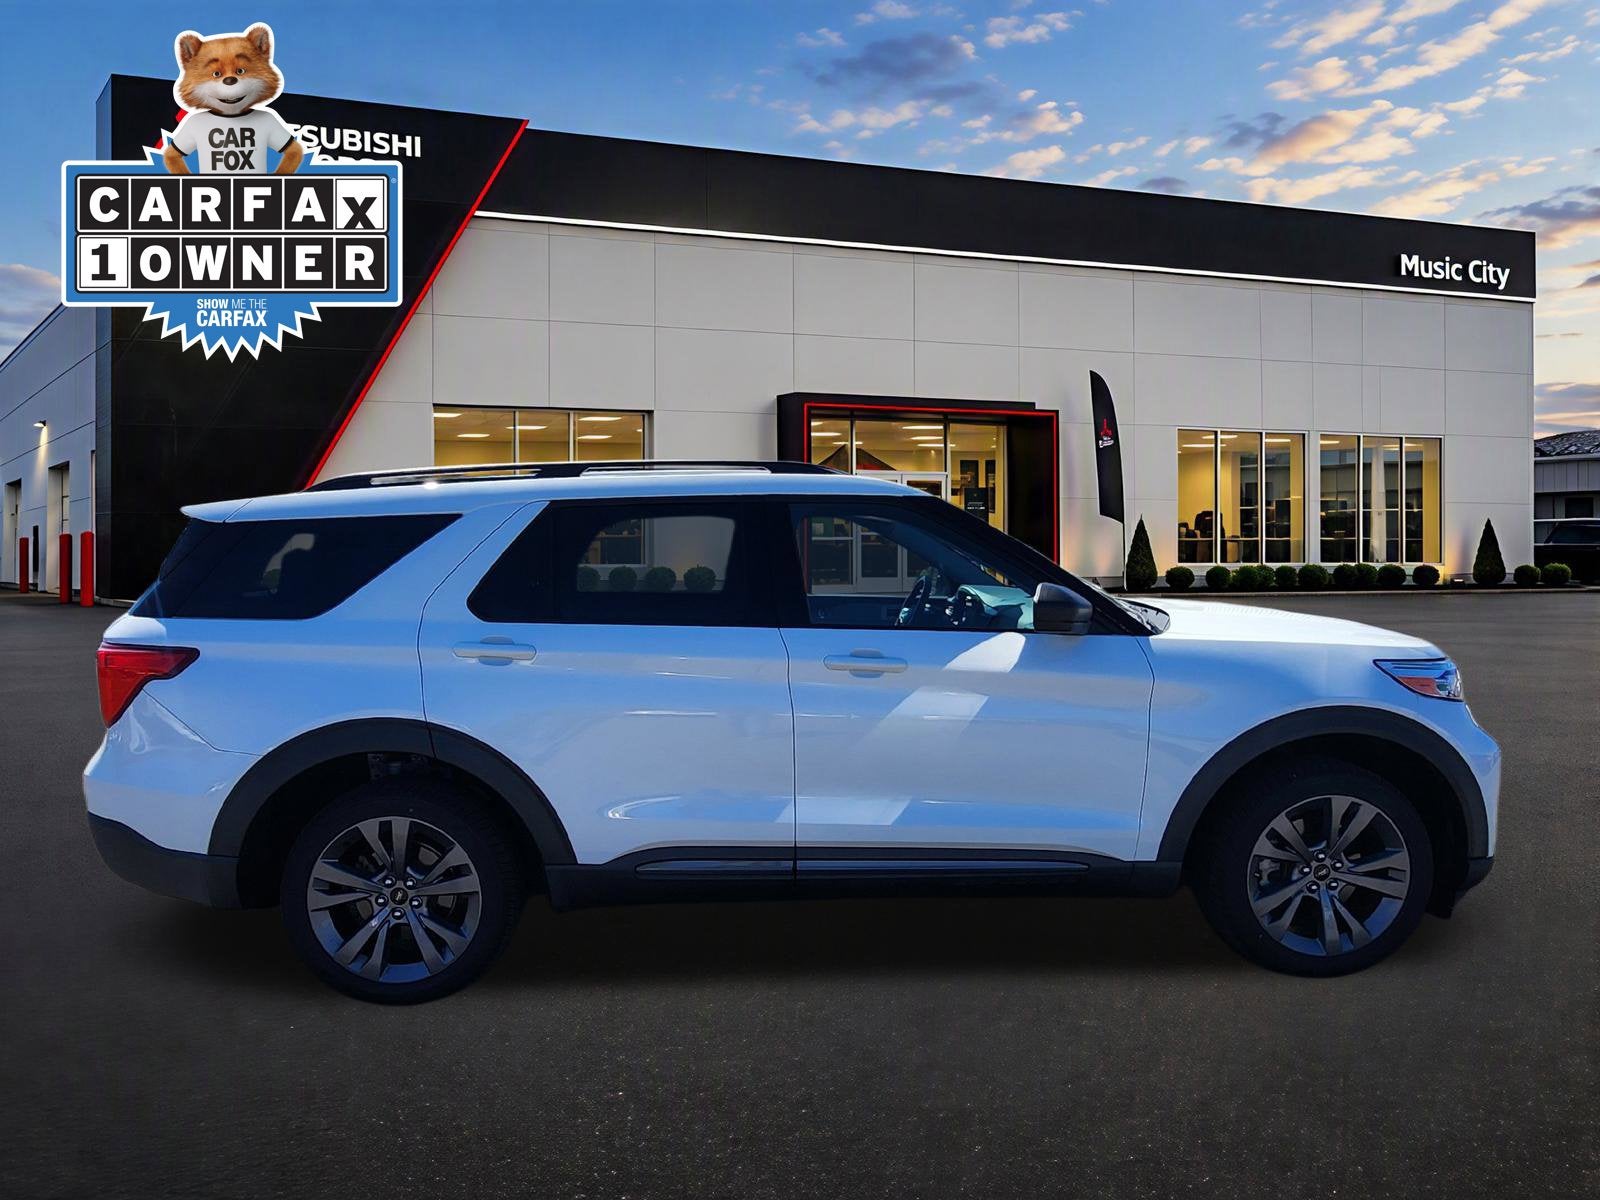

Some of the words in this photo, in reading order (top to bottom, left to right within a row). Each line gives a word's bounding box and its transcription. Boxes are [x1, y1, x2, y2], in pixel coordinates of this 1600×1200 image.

[288, 123, 421, 158] SUBISHI
[1400, 253, 1462, 281] Music
[1468, 259, 1511, 290] City
